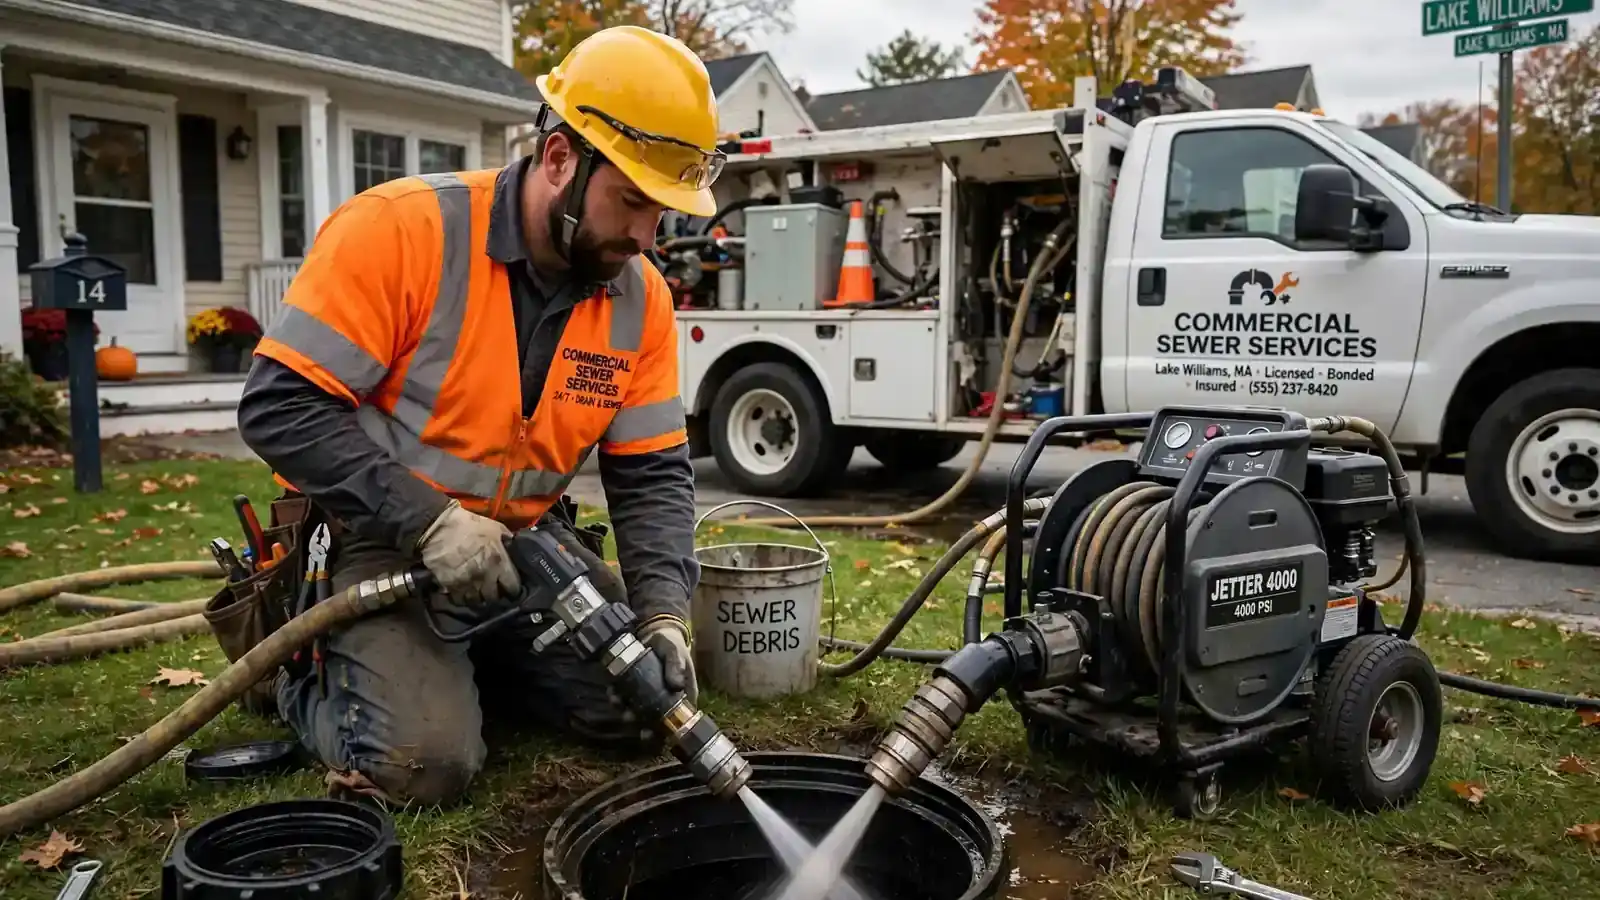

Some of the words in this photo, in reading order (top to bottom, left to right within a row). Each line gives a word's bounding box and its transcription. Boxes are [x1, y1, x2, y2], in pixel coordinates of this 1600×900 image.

[1426, 1, 1470, 30] LAKE
[1458, 36, 1484, 54] LAKE
[1487, 28, 1537, 49] WILLIAMS
[1548, 24, 1564, 39] MA
[77, 279, 107, 303] 14
[1174, 312, 1360, 333] COMMERCIAL
[1156, 334, 1241, 355] SEWER
[1248, 335, 1377, 358] SERVICES
[562, 347, 631, 372] COMMERCIAL
[575, 364, 614, 382] SEWER
[1155, 364, 1180, 376] Lake
[1182, 364, 1231, 378] Williams,
[1234, 365, 1252, 377] MA
[1265, 366, 1315, 380] Licensed
[1327, 368, 1375, 381] Bonded
[552, 390, 571, 403] 24/7
[575, 394, 596, 408] DRAIN
[565, 377, 619, 397] SERVICES
[1195, 380, 1237, 392] Insured
[1249, 381, 1279, 396] (555)
[1282, 383, 1338, 396] 237-8420
[1211, 573, 1264, 601] JETTER
[1266, 568, 1298, 591] 4000
[716, 599, 797, 624] SEWER
[1233, 602, 1256, 618] 4000
[1258, 599, 1273, 614] PSI
[723, 627, 800, 654] DEBRIS
